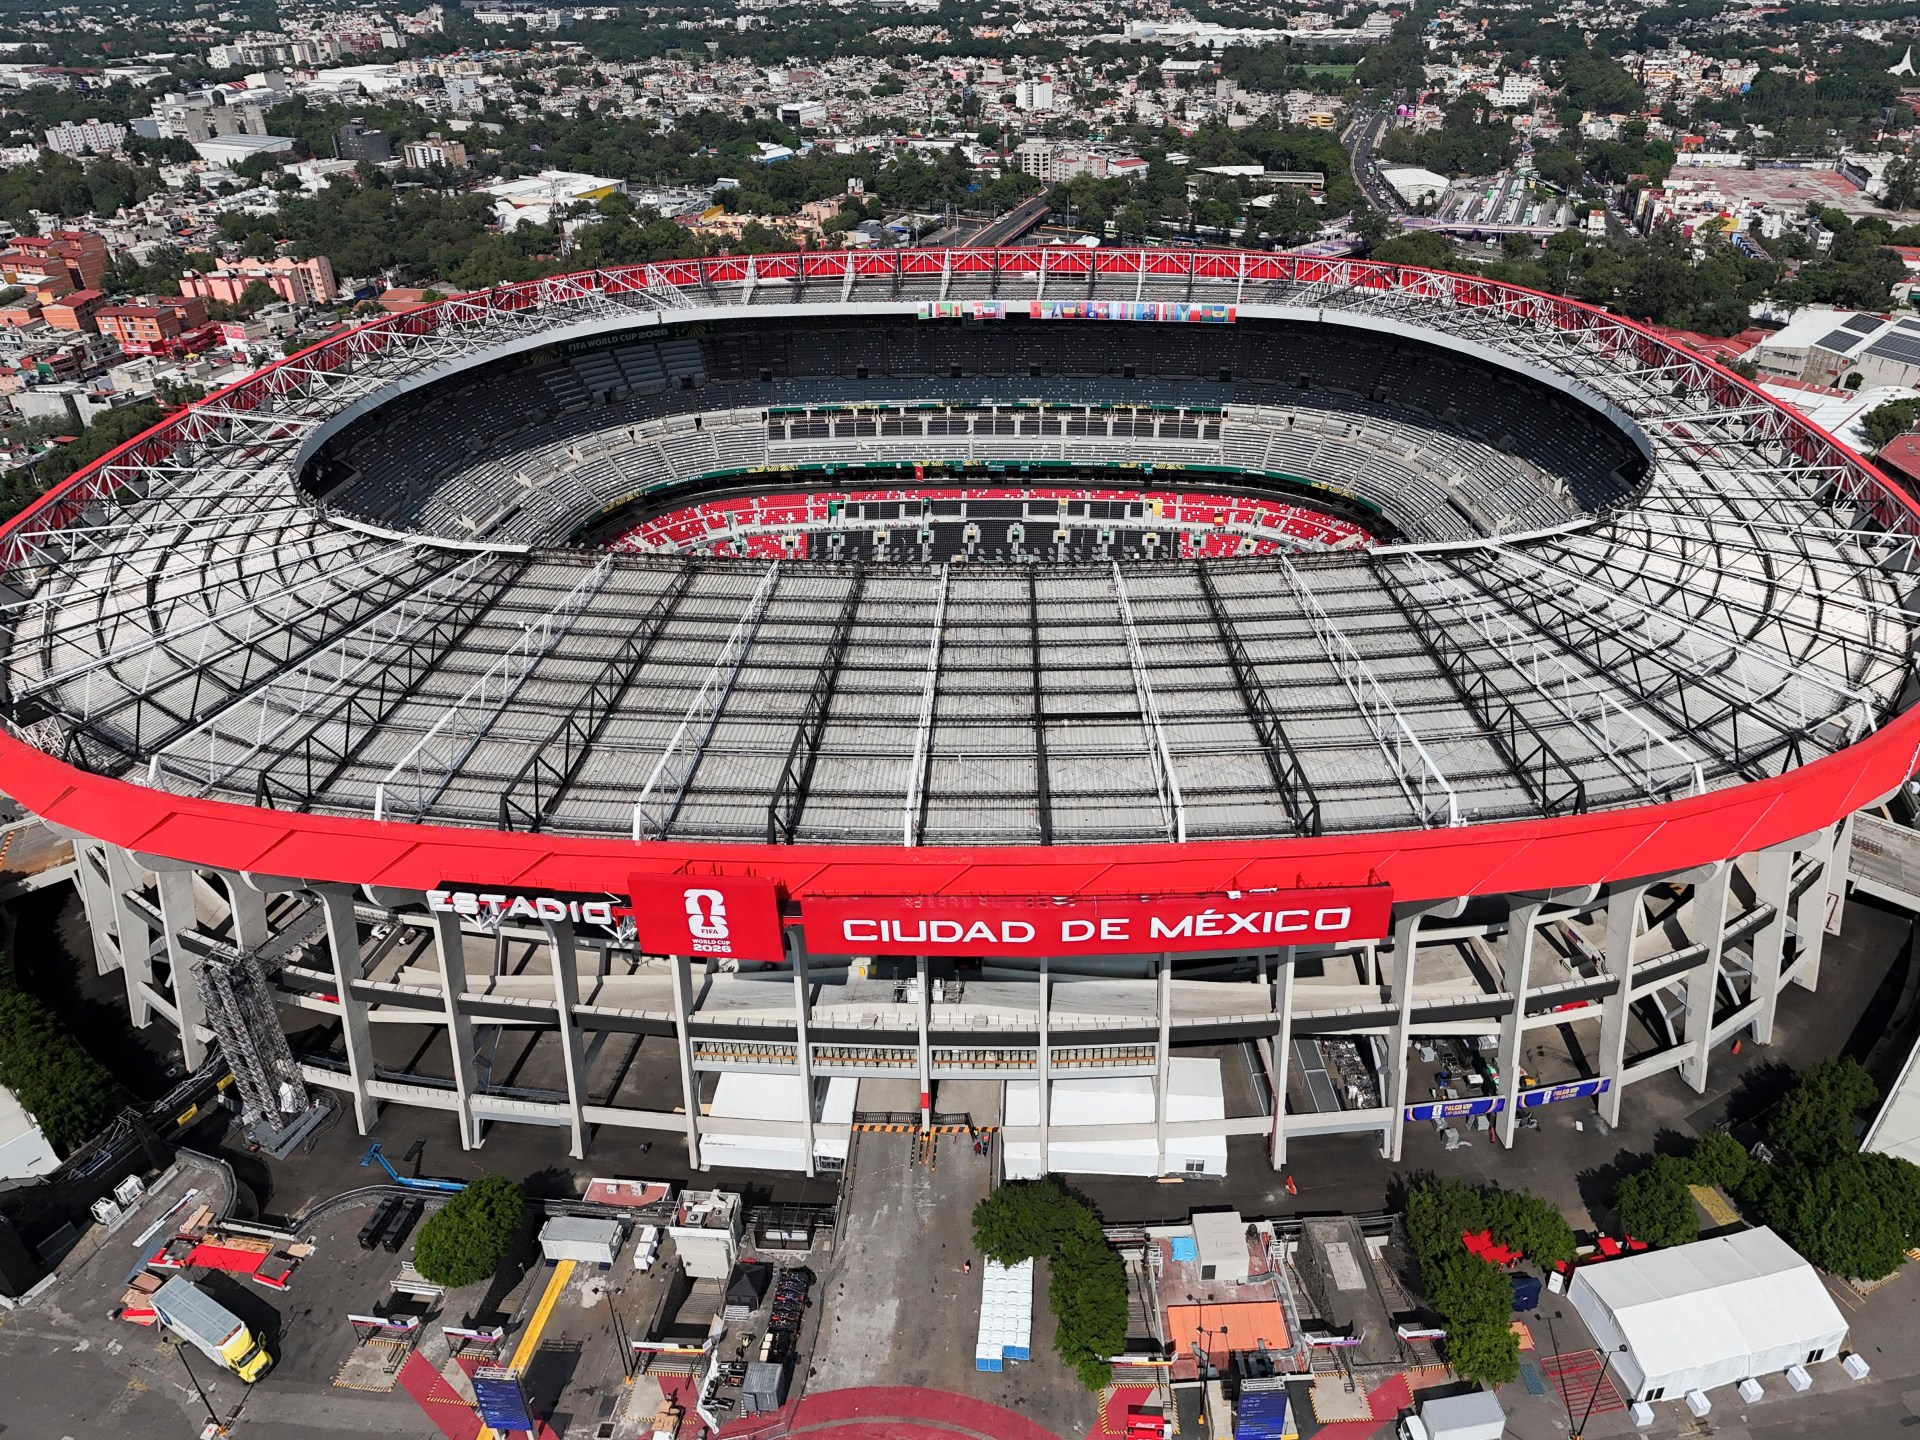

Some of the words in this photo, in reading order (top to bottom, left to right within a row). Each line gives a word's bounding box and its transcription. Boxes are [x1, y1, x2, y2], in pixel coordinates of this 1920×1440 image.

[568, 342, 587, 352] FIFA
[588, 336, 618, 348] WORLD
[620, 333, 637, 342] CUP
[638, 328, 669, 339] 2026
[666, 478, 689, 486] MEXICO
[425, 889, 613, 925] ESTADIO
[843, 919, 1036, 943] CIUDAD
[1061, 917, 1129, 941] DE
[1150, 905, 1352, 939] MÉXICO
[693, 944, 732, 953] 2026
